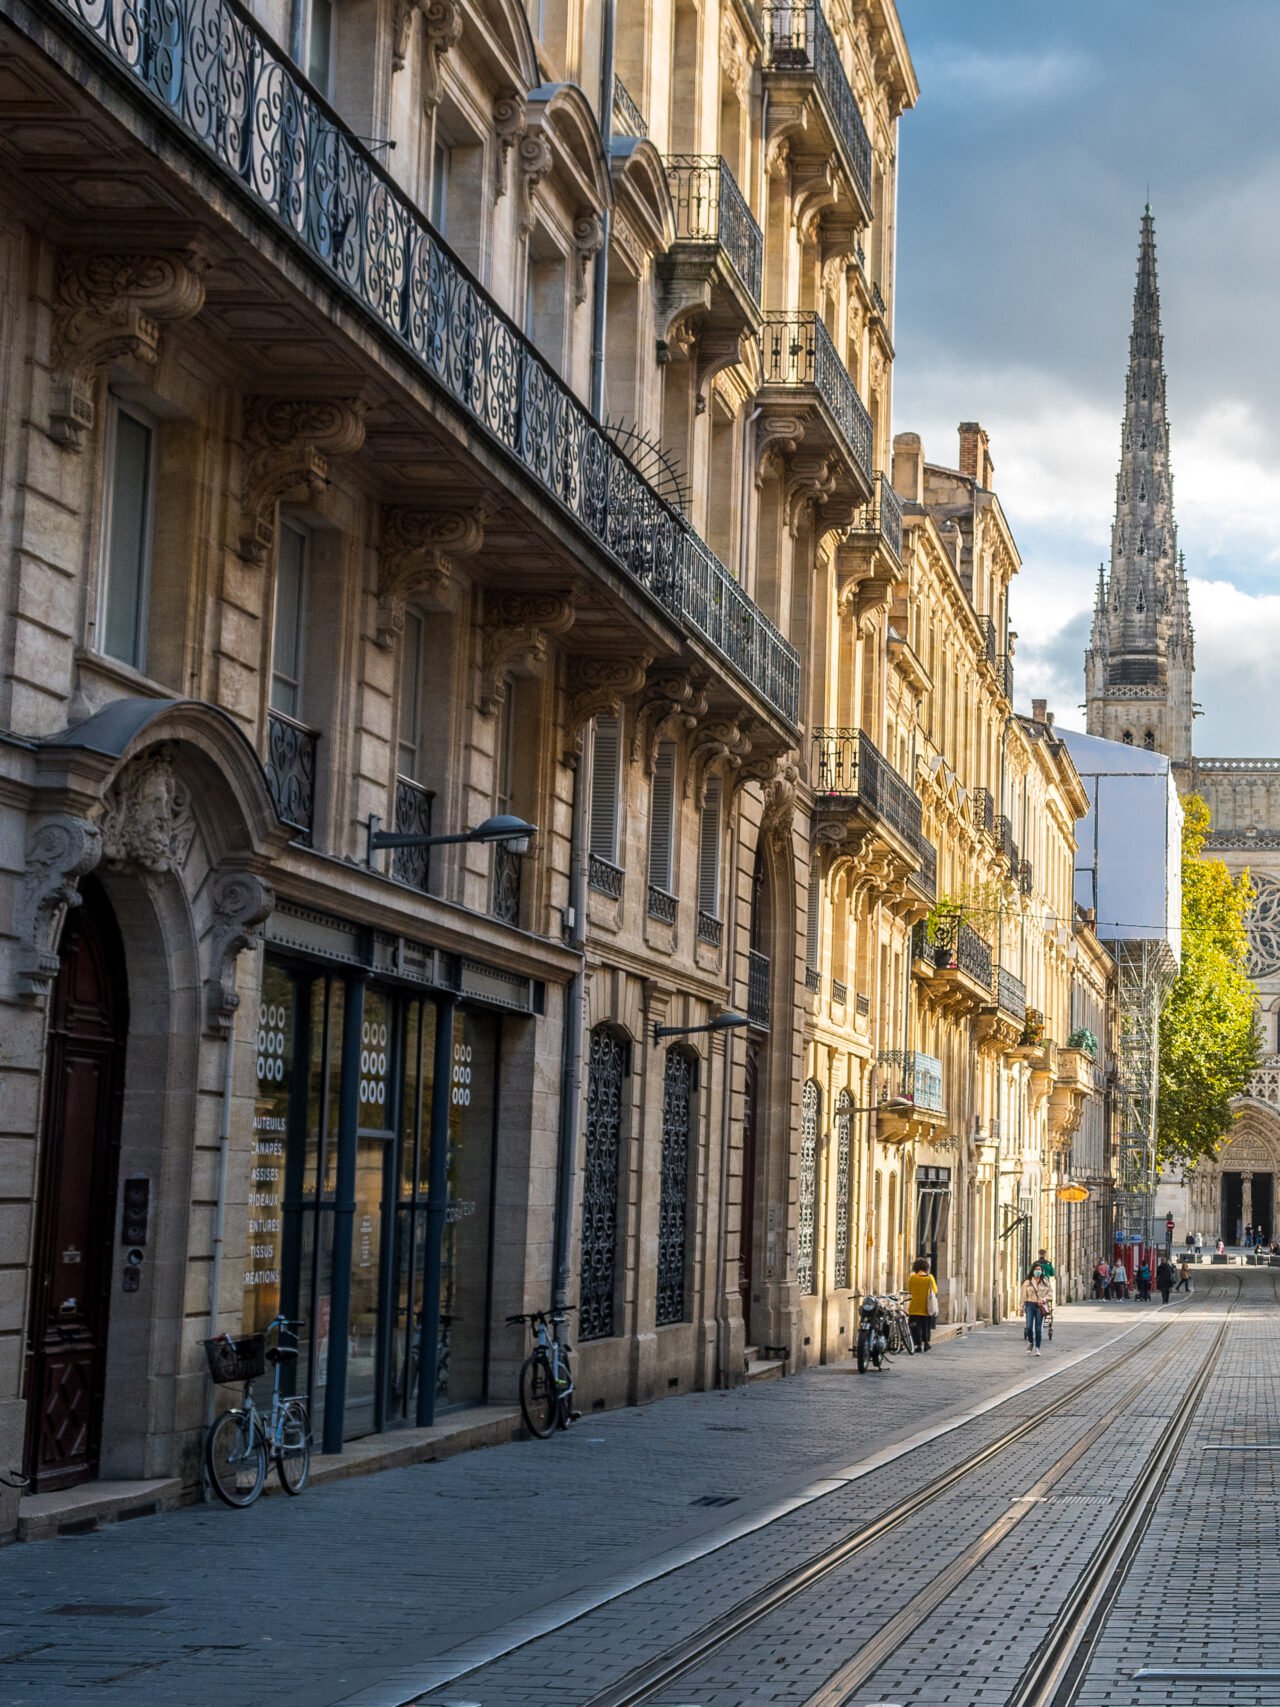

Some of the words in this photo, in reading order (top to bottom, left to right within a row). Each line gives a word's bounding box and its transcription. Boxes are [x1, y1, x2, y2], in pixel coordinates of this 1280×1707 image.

[252, 1116, 286, 1131] AUTEUILS
[251, 1168, 279, 1181] ASSISES
[248, 1219, 281, 1233] ENTURES
[250, 1245, 273, 1258] TISSUS
